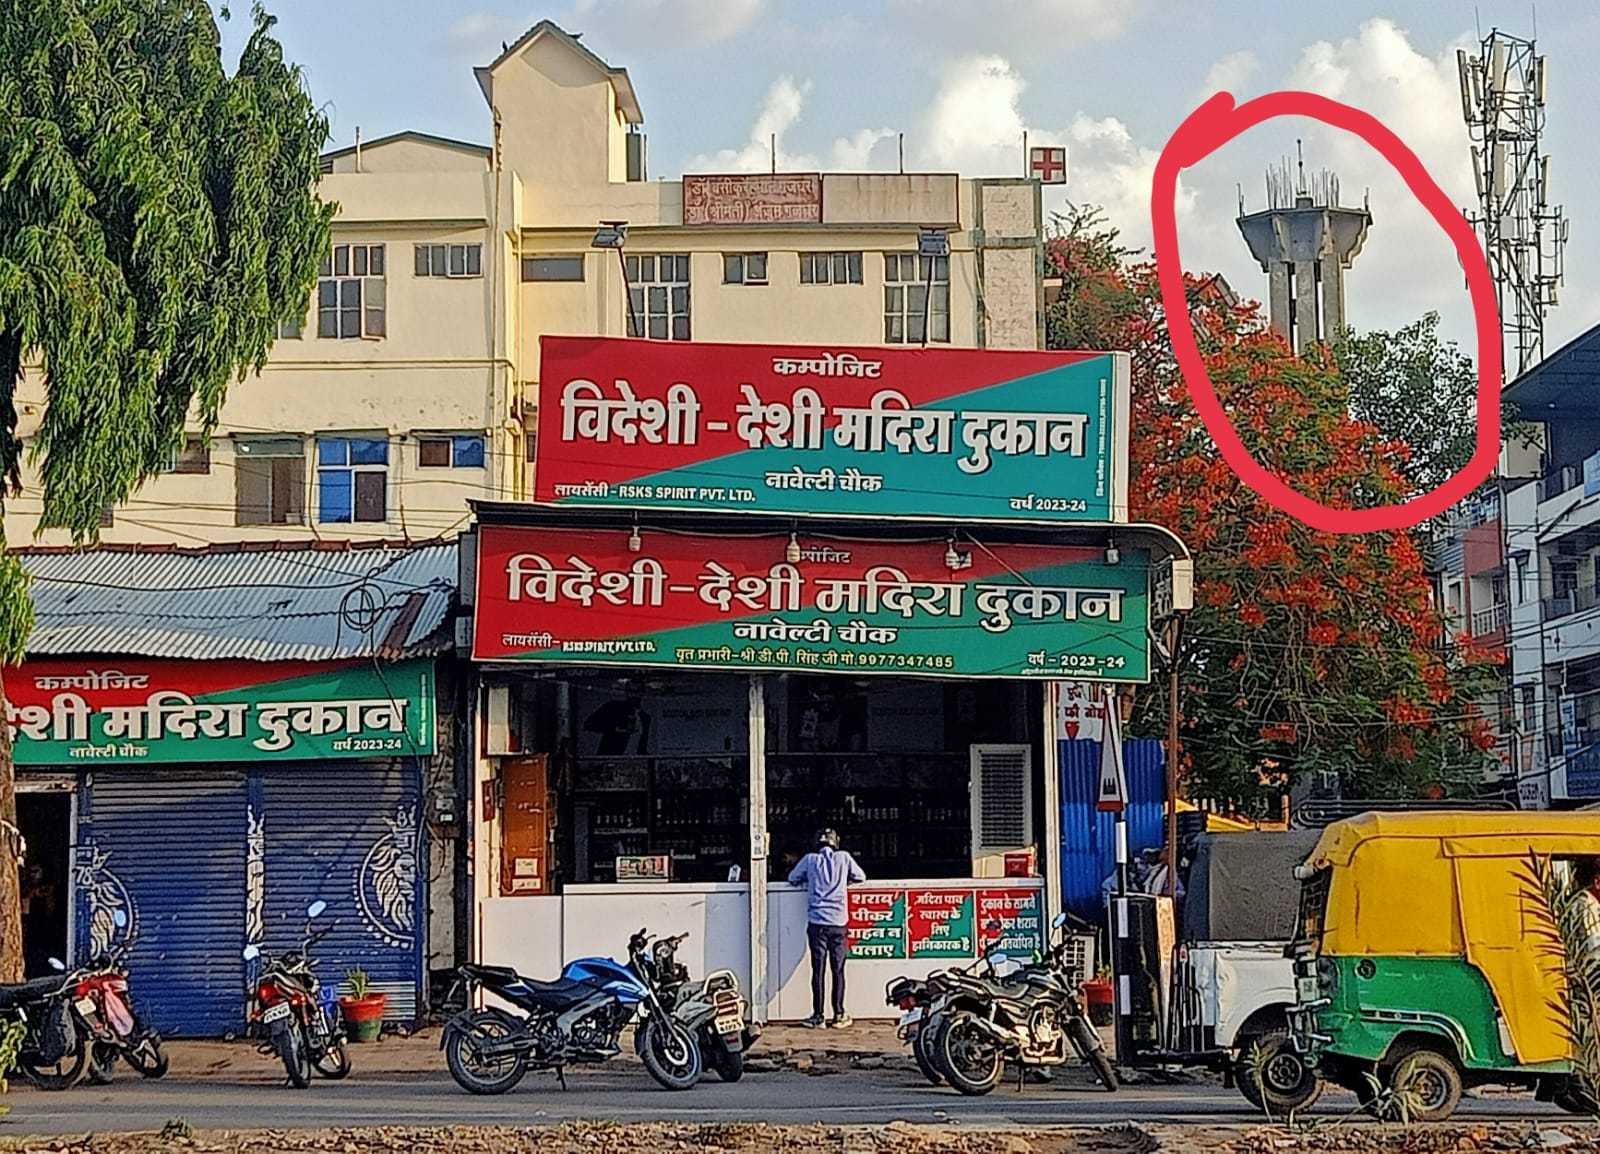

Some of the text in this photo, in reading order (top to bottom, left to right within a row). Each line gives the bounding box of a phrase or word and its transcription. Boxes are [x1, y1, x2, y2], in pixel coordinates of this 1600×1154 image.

[773, 352, 881, 378] कम्पोजिट
[561, 380, 700, 445] विदेशी
[736, 385, 825, 449] देशी
[833, 390, 955, 453] मदिरा
[957, 411, 1088, 474] दुकान
[766, 466, 882, 491] नावेल्टी चौक
[619, 486, 651, 498] RSKS
[656, 487, 696, 499] SPIRIT
[700, 488, 726, 501] PVT.
[729, 489, 756, 501] LTD.
[1010, 495, 1086, 512] वर्ष 2023-24
[800, 547, 850, 563] म्पोजिट
[815, 567, 965, 617] मदिरा
[976, 584, 1124, 631] दुकान
[734, 618, 898, 643] नावेल्टी चौक
[822, 650, 837, 665] जी
[34, 670, 149, 690] कम्पोजिट
[101, 691, 247, 739] मदिरा
[254, 699, 407, 749] दुकान
[353, 738, 402, 750] 2023-24
